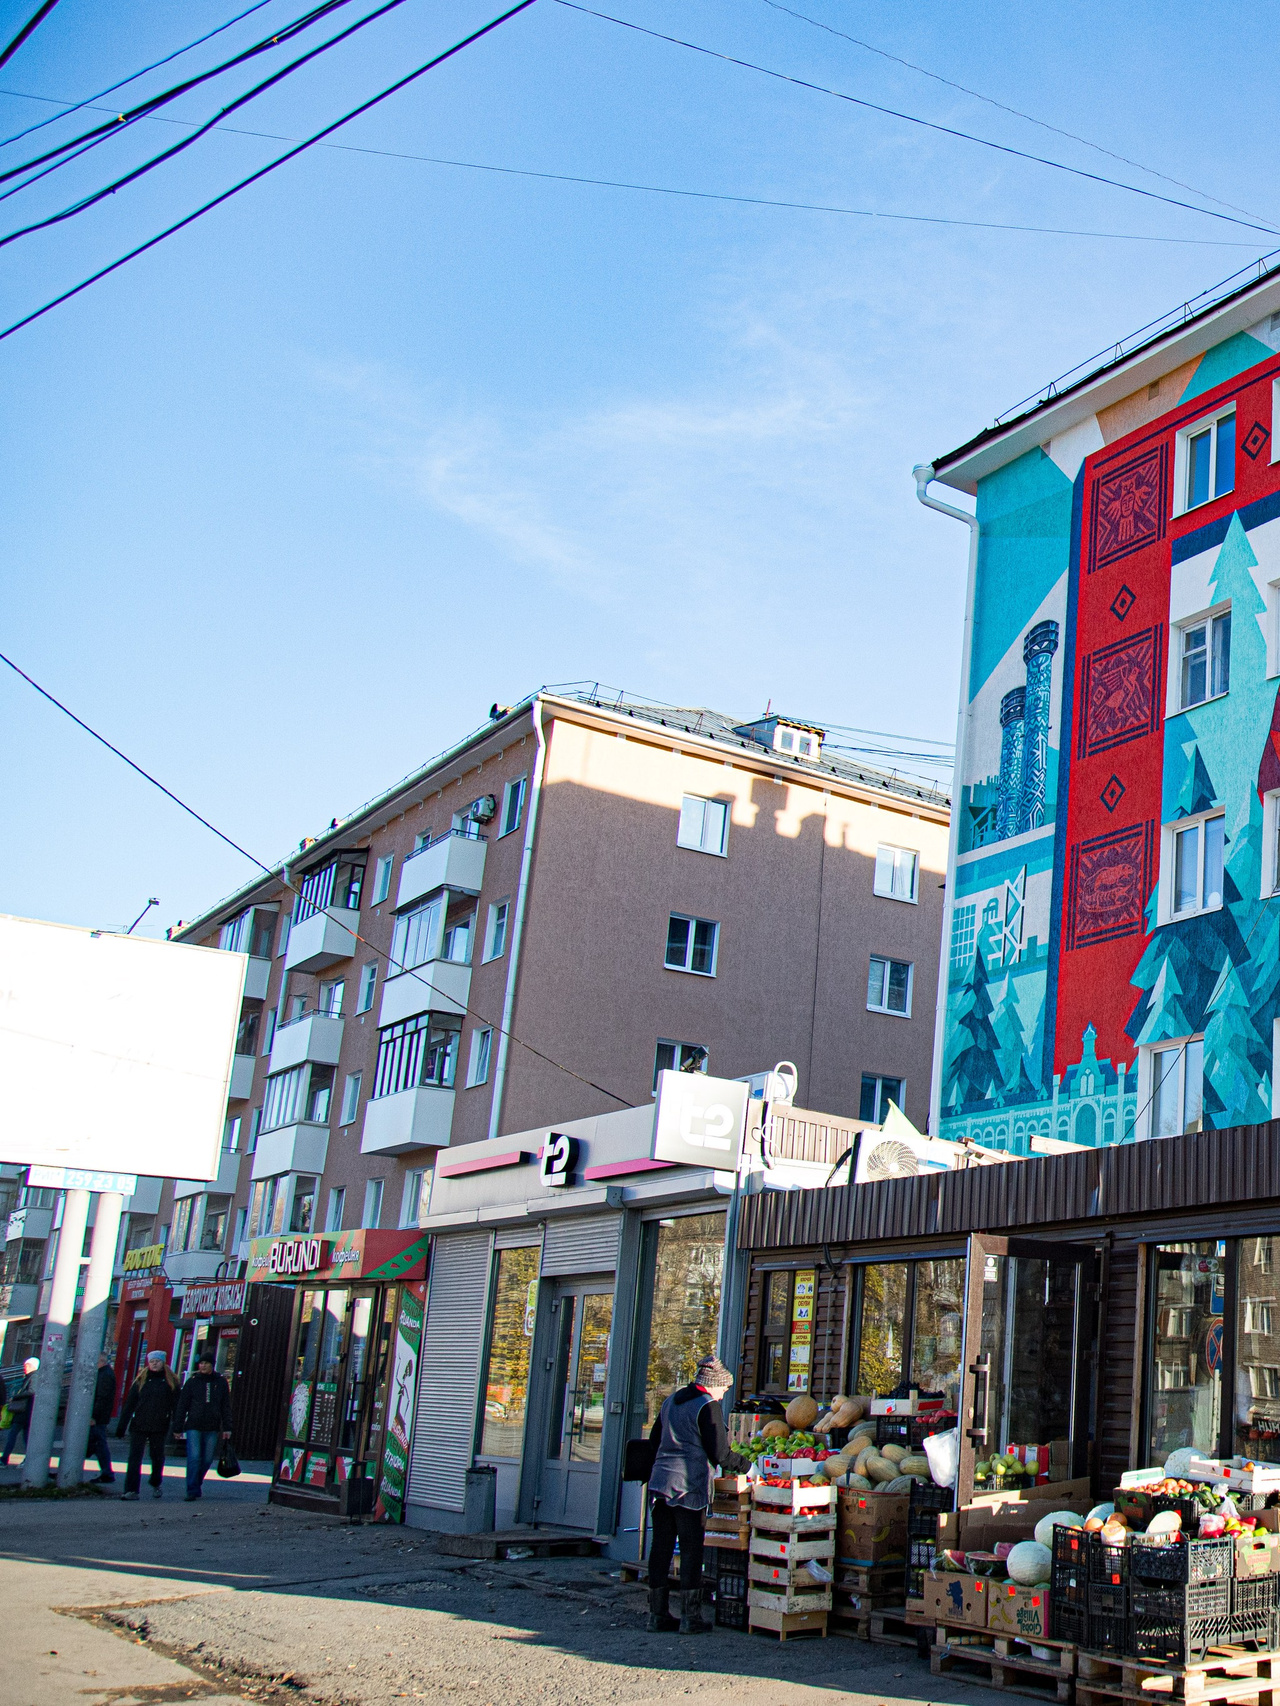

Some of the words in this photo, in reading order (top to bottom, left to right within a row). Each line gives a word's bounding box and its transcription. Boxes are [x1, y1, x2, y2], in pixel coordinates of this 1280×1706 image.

[66, 1171, 93, 1187] 259
[116, 1175, 134, 1191] 05
[269, 1239, 322, 1275] BURUNDI
[332, 1247, 360, 1267] кофейня
[1020, 1622, 1042, 1636] Global
